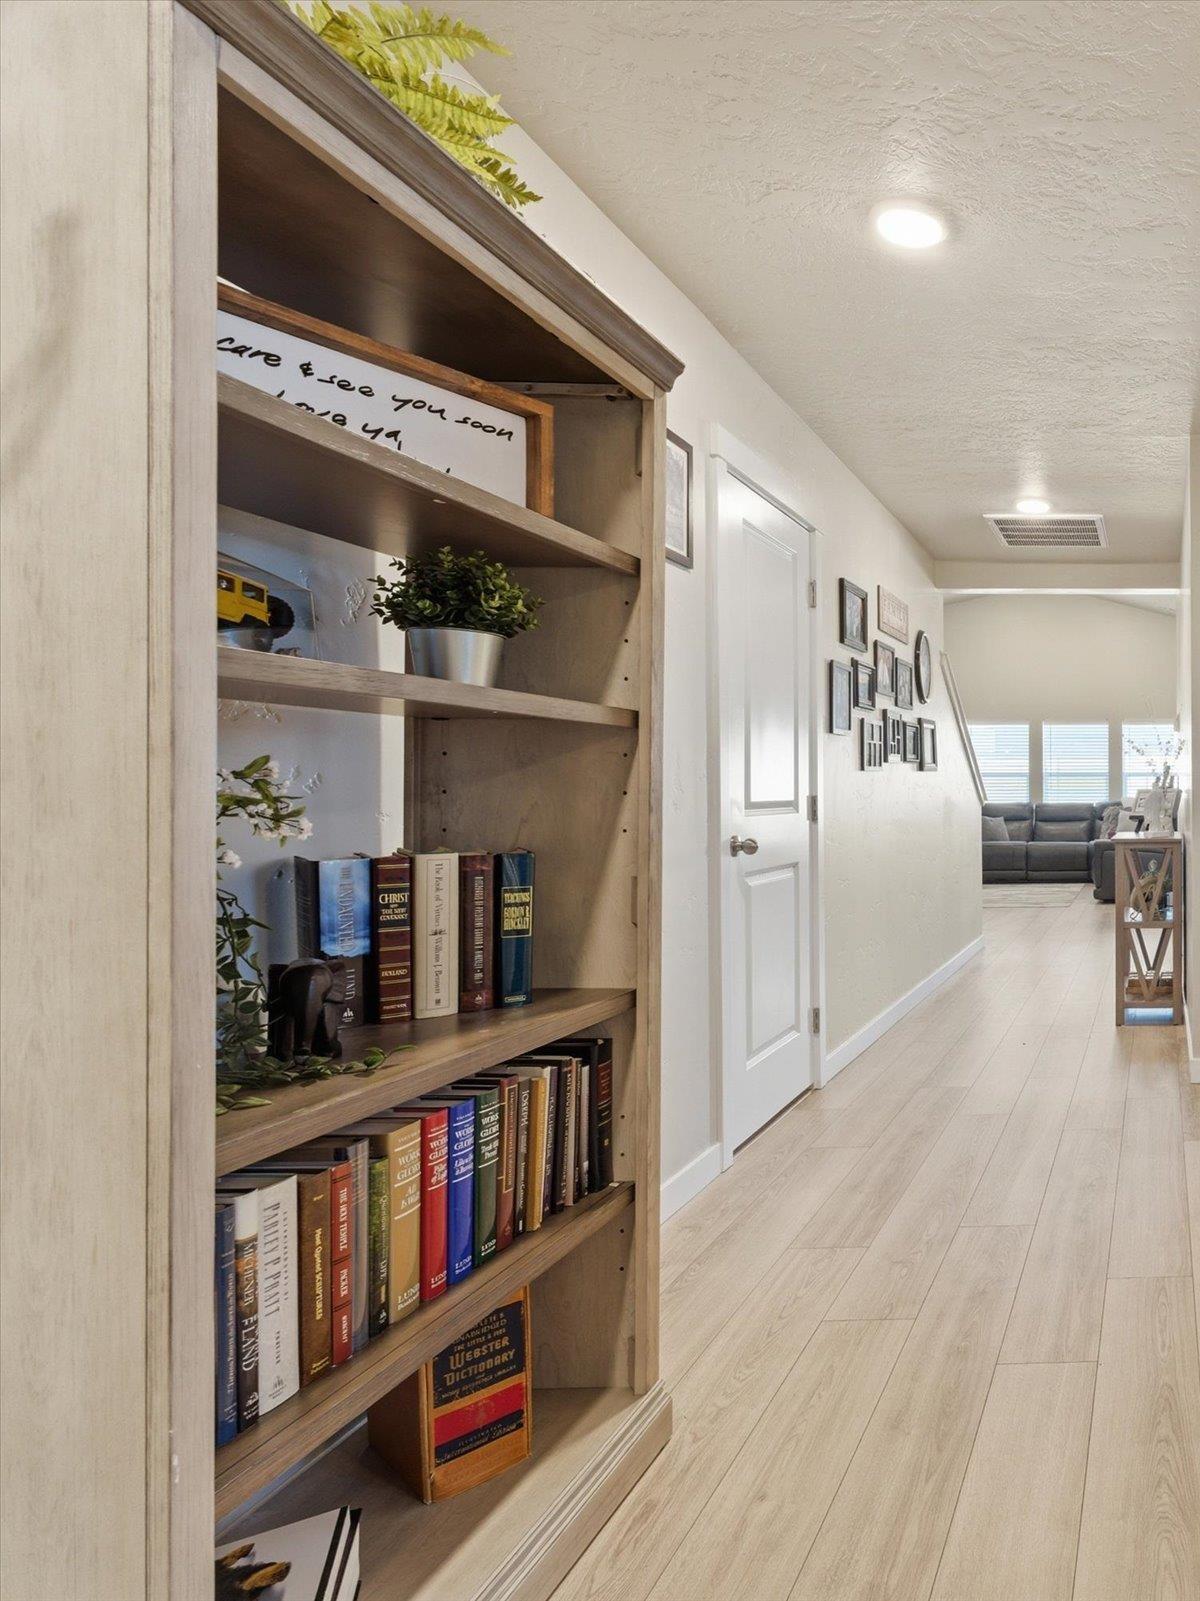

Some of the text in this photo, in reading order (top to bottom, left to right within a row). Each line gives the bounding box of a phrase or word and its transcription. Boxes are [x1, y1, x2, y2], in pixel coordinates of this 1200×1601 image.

[217, 336, 282, 367] care
[317, 375, 375, 398] see
[391, 393, 447, 420] you
[454, 416, 513, 441] soon
[434, 863, 443, 875] The
[336, 880, 357, 952] UNDAUNTED
[379, 893, 409, 905] CHRIST
[344, 968, 356, 1001] LUND
[521, 1090, 530, 1127] JOSEPH
[263, 1202, 280, 1255] PARLEY
[264, 1271, 281, 1317] PRATT
[442, 1349, 517, 1386] DICTIONARY
[449, 1336, 511, 1370] WEBSTER
